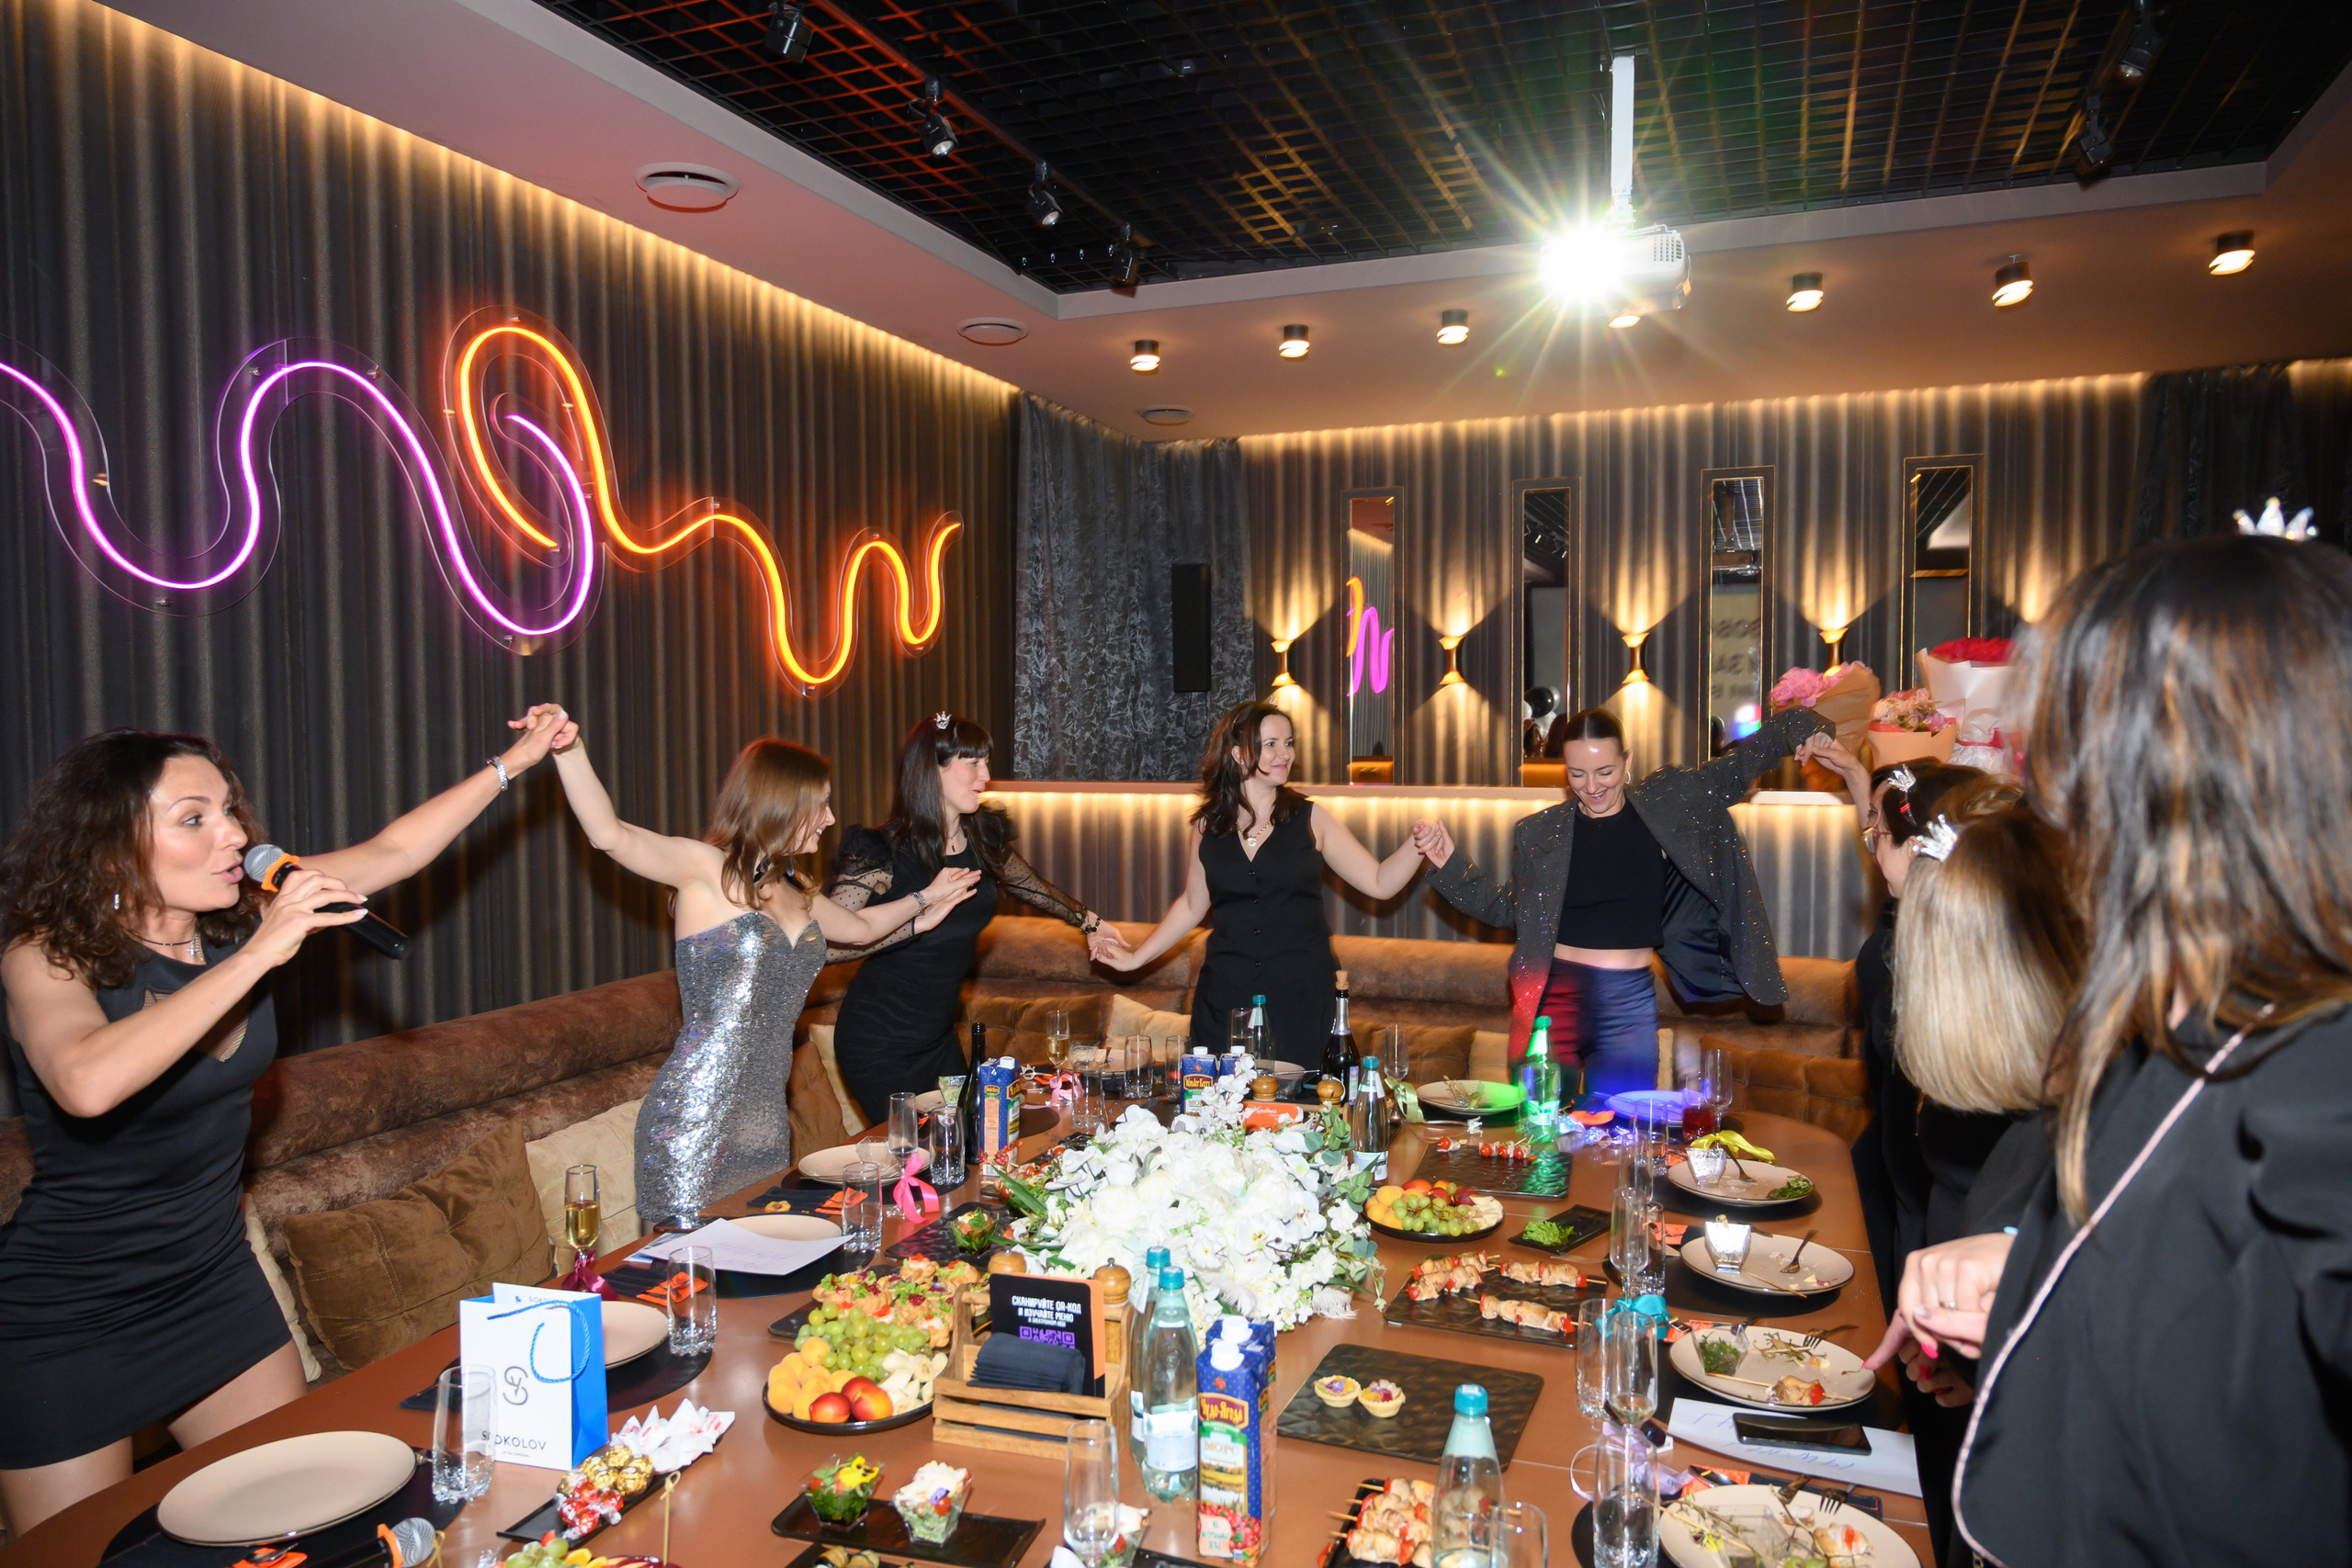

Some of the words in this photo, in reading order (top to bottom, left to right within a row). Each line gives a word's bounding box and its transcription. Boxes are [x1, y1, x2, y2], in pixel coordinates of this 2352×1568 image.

[1012, 1295, 1055, 1310] СКАНИРУЙТЕ
[1023, 1308, 1055, 1320] ИЗУЧАЙТЕ
[1055, 1312, 1074, 1323] МЕНЮ
